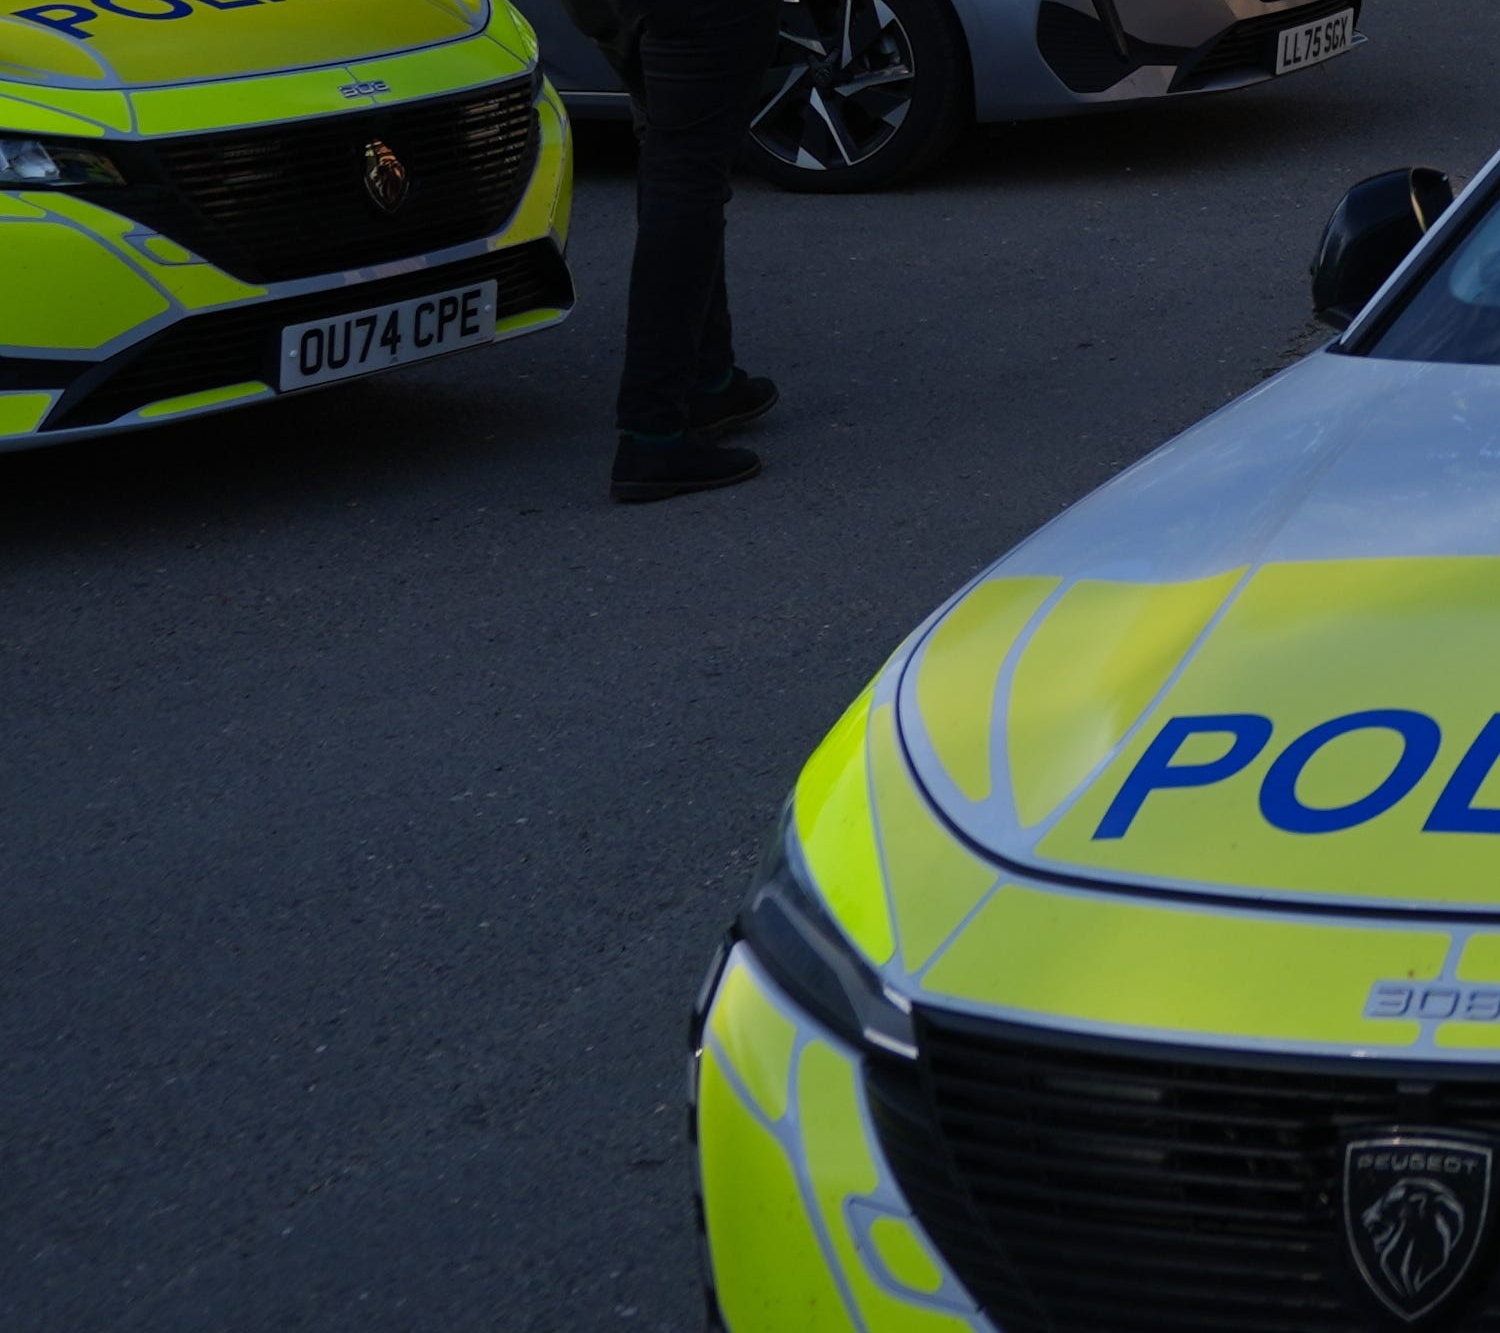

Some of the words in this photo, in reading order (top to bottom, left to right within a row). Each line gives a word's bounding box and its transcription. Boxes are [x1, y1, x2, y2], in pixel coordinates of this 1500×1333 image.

[300, 310, 401, 376] OU74
[414, 289, 482, 348] CPE
[1357, 1153, 1479, 1174] PEUGEOT
